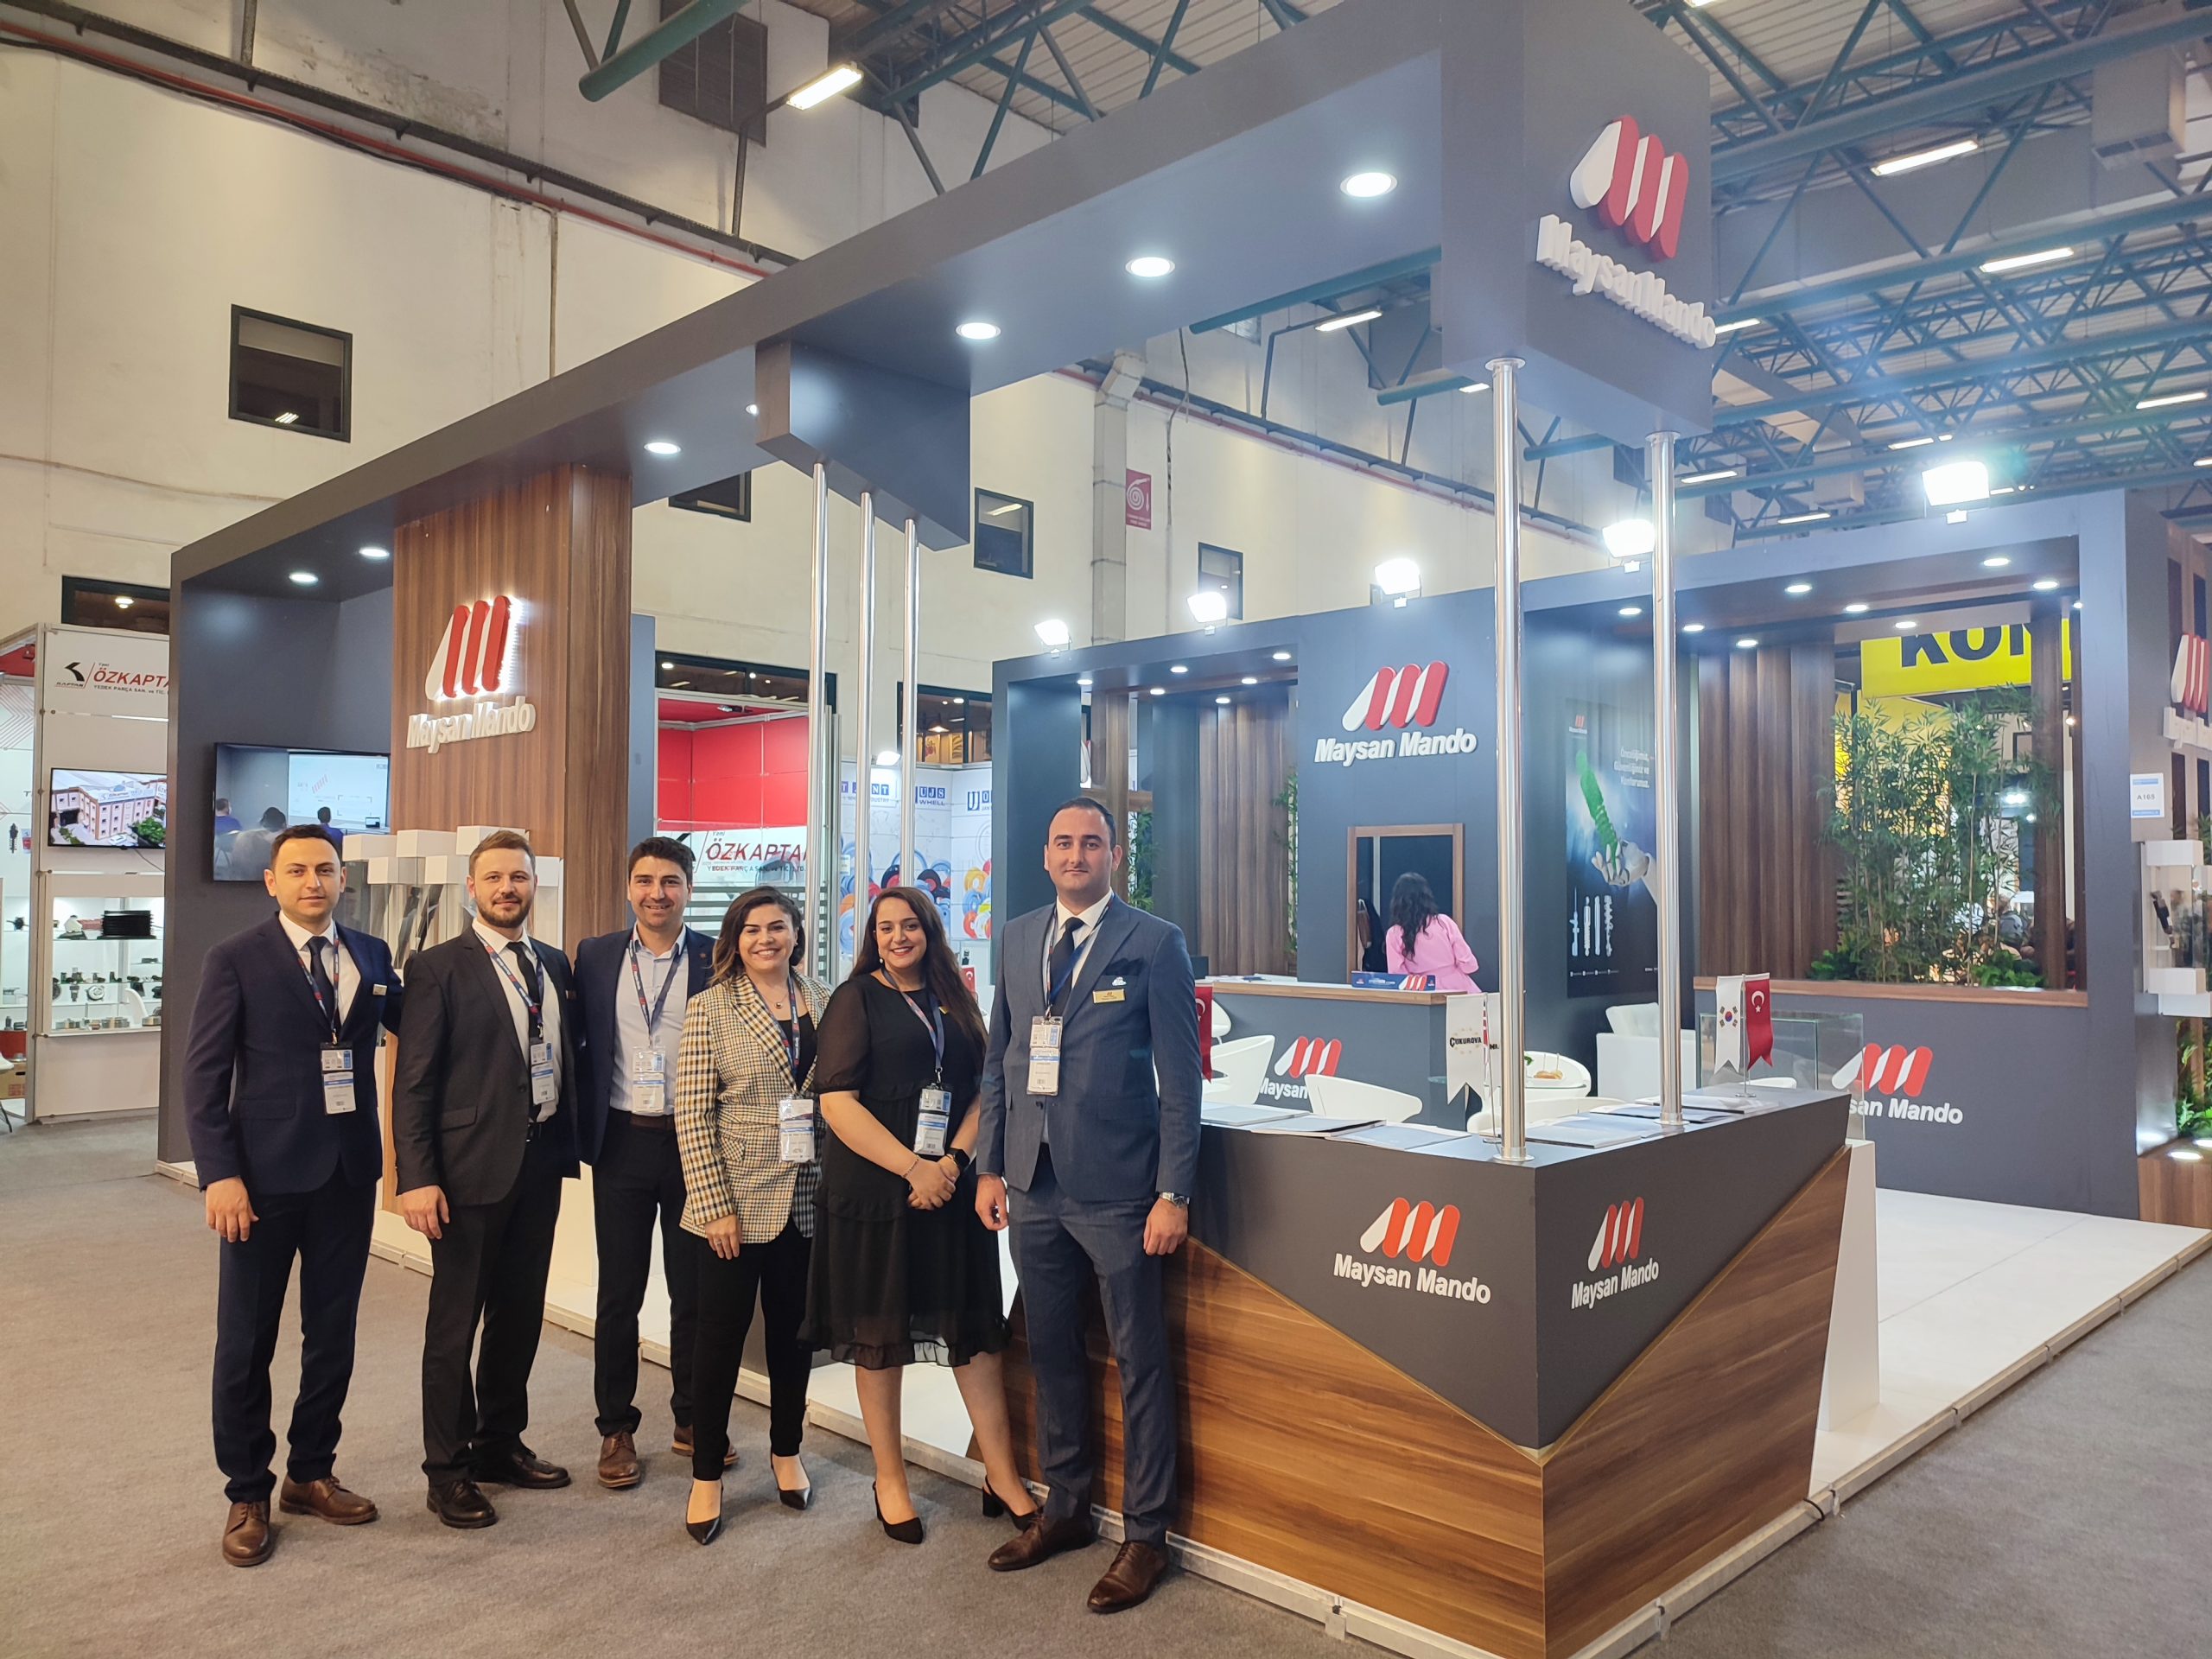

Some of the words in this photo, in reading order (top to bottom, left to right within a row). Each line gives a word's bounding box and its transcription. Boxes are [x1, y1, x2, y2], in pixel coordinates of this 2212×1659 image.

[406, 713, 473, 754] Maysan
[471, 695, 536, 739] Mando
[1313, 737, 1396, 767] Maysan
[1398, 728, 1478, 758] Mando
[918, 785, 945, 799] UJS
[1849, 1098, 1883, 1117] san
[1888, 1097, 1964, 1124] Mando
[1333, 1253, 1412, 1288] Maysan
[1415, 1267, 1491, 1305] Mando
[1571, 1275, 1618, 1310] Maysan
[1620, 1257, 1659, 1292] Mando
